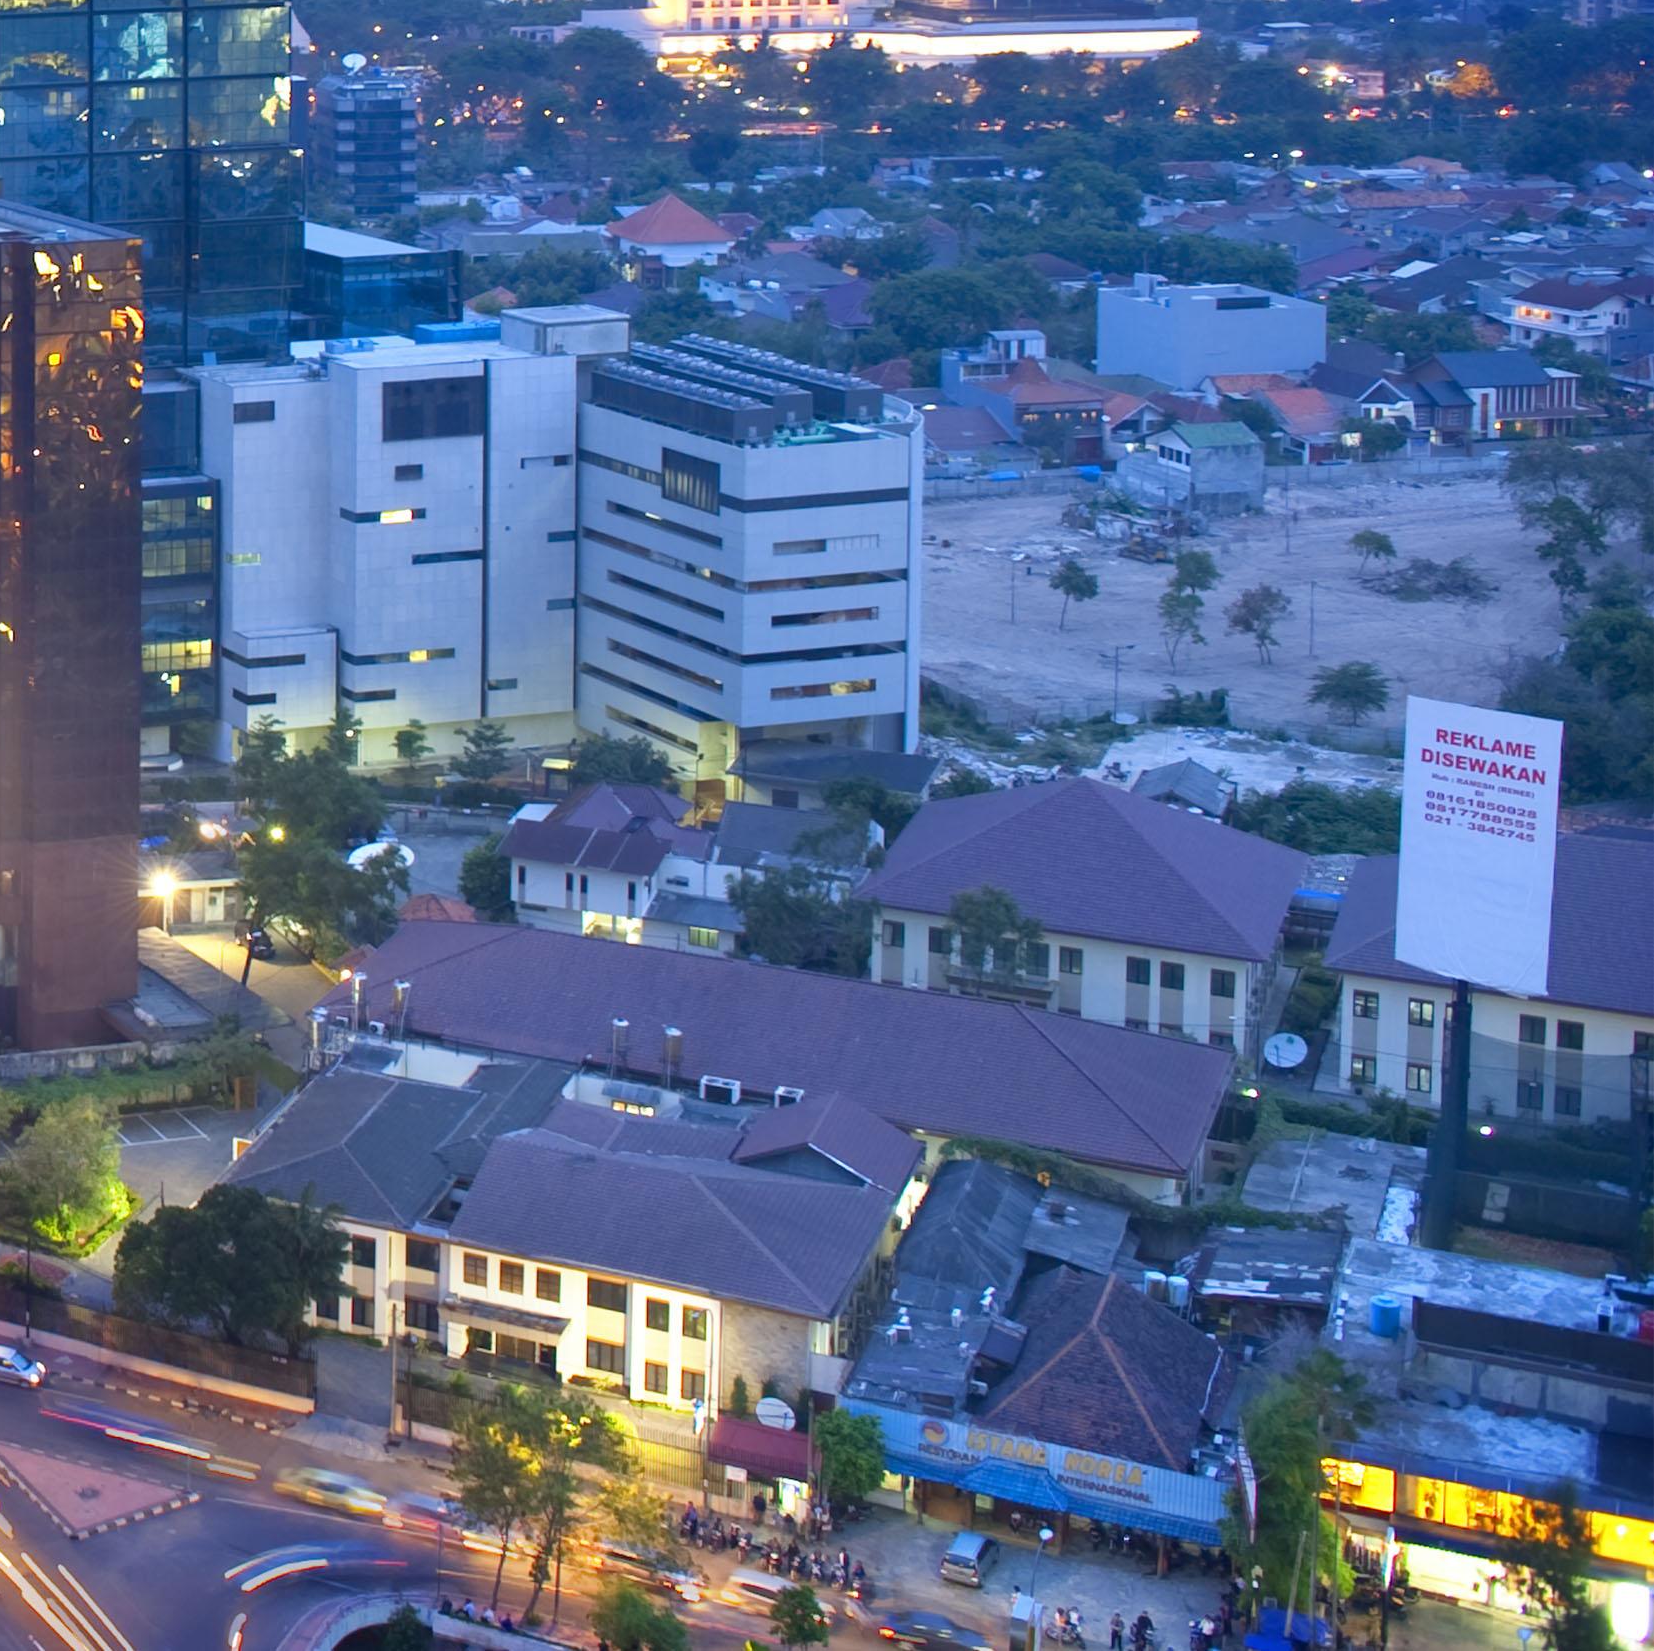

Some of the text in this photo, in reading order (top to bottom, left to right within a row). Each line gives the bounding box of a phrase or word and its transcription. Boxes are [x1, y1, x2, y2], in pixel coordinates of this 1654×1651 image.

[1436, 728, 1536, 760] REKLAME
[1421, 748, 1546, 785] DISEWAKAN
[1424, 813, 1451, 826] 021
[1467, 822, 1535, 843] 3842745
[918, 1443, 1153, 1504] RESTORAN INTERNASIONAL
[965, 1428, 1143, 1486] ISTANA KOREA
